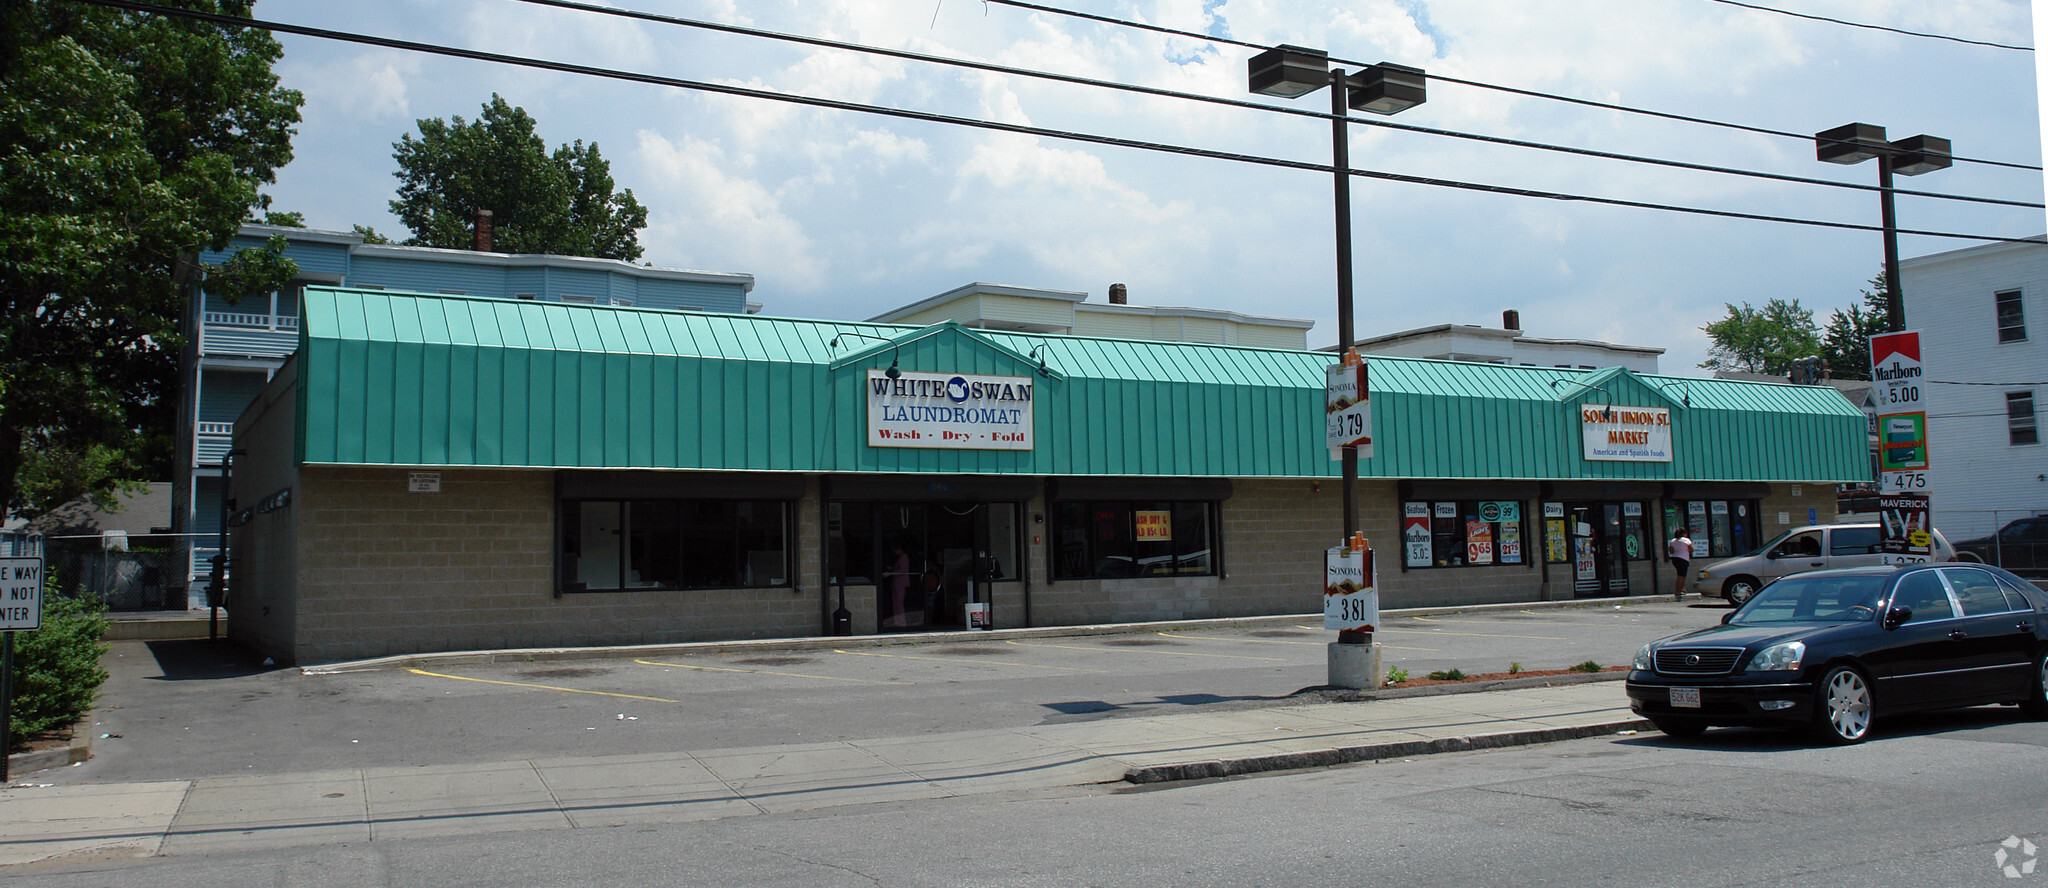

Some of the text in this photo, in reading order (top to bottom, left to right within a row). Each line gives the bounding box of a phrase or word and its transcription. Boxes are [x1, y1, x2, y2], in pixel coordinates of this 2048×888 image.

[1875, 362, 1921, 380] Marlboro
[871, 378, 1032, 401] WHITE SWAN
[1330, 382, 1356, 393] SONOMA
[1890, 386, 1918, 402] 5.00
[882, 406, 1020, 424] LAUNDROMAT
[1621, 412, 1654, 426] UNION
[1656, 414, 1670, 426] ST.
[1337, 413, 1362, 437] 3.79
[879, 430, 1024, 442] Wash Dry Fold
[1608, 431, 1648, 444] MARKET
[1883, 439, 1923, 452] pleasure!
[1896, 474, 1926, 489] 4.75
[1406, 506, 1426, 514] Seafood
[1437, 506, 1454, 514] Frozen
[1546, 506, 1562, 514] Dairy
[1880, 500, 1928, 508] MAVERICK
[1136, 516, 1148, 524] ASH
[1150, 516, 1160, 524] DRY
[1407, 530, 1430, 542] Marlboro
[14, 567, 38, 580] WAY
[1330, 566, 1362, 576] SONOMA
[12, 587, 34, 600] NOT
[0, 608, 28, 620] NTER
[1342, 598, 1365, 622] 3.81
